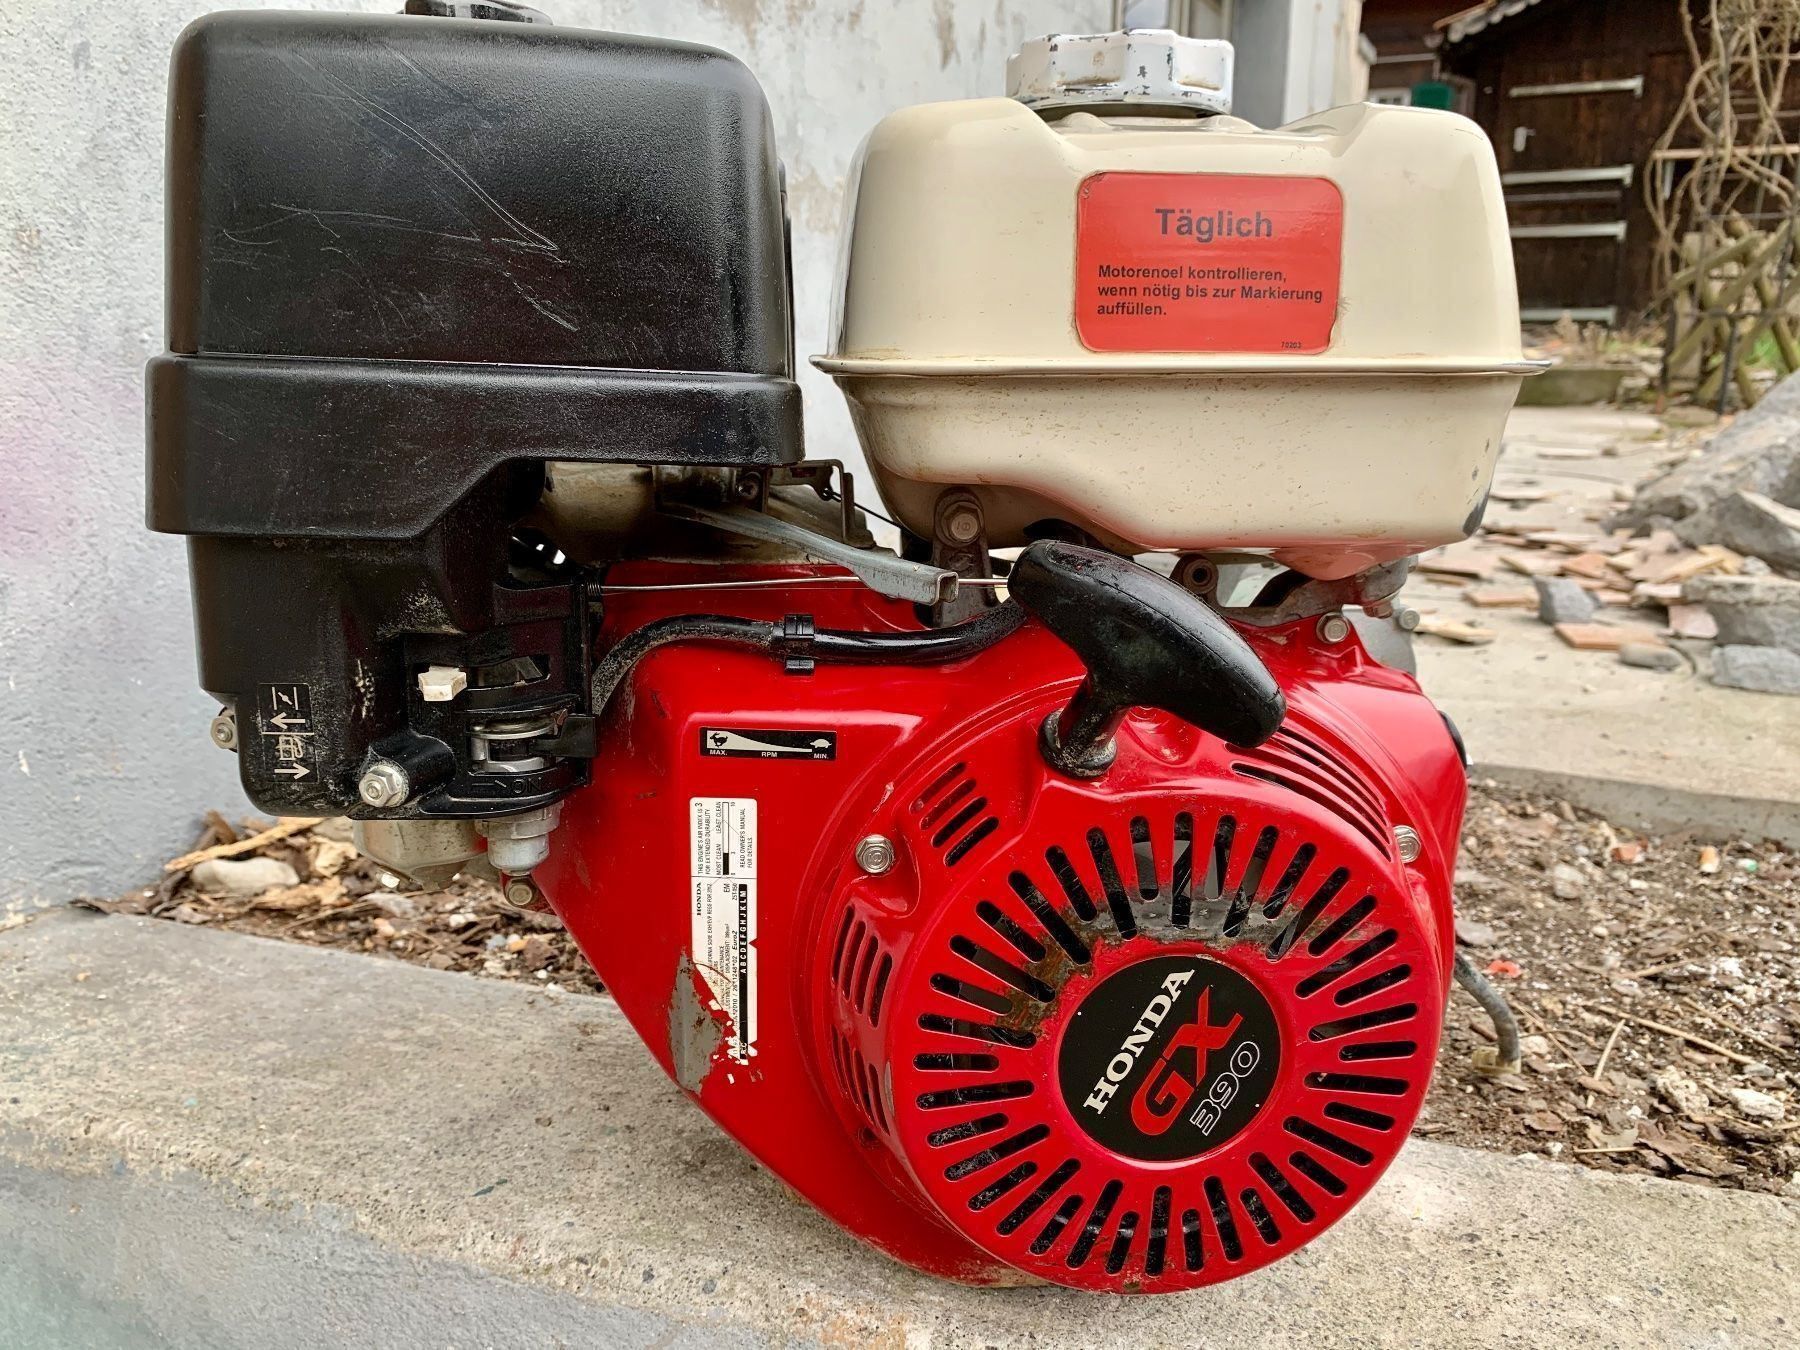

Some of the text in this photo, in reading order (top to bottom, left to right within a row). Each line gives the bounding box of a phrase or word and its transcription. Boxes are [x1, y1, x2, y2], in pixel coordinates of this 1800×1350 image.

[1155, 208, 1272, 243] Täglich
[1098, 265, 1287, 283] Motorenoel kontrollieren,
[1097, 284, 1323, 303] wenn nötig bis zur Markierung
[1097, 302, 1167, 315] auffüllen.
[724, 884, 730, 893] EM
[1083, 969, 1195, 1114] HONDA
[1131, 985, 1243, 1136] GX
[1189, 1041, 1260, 1136] 390
